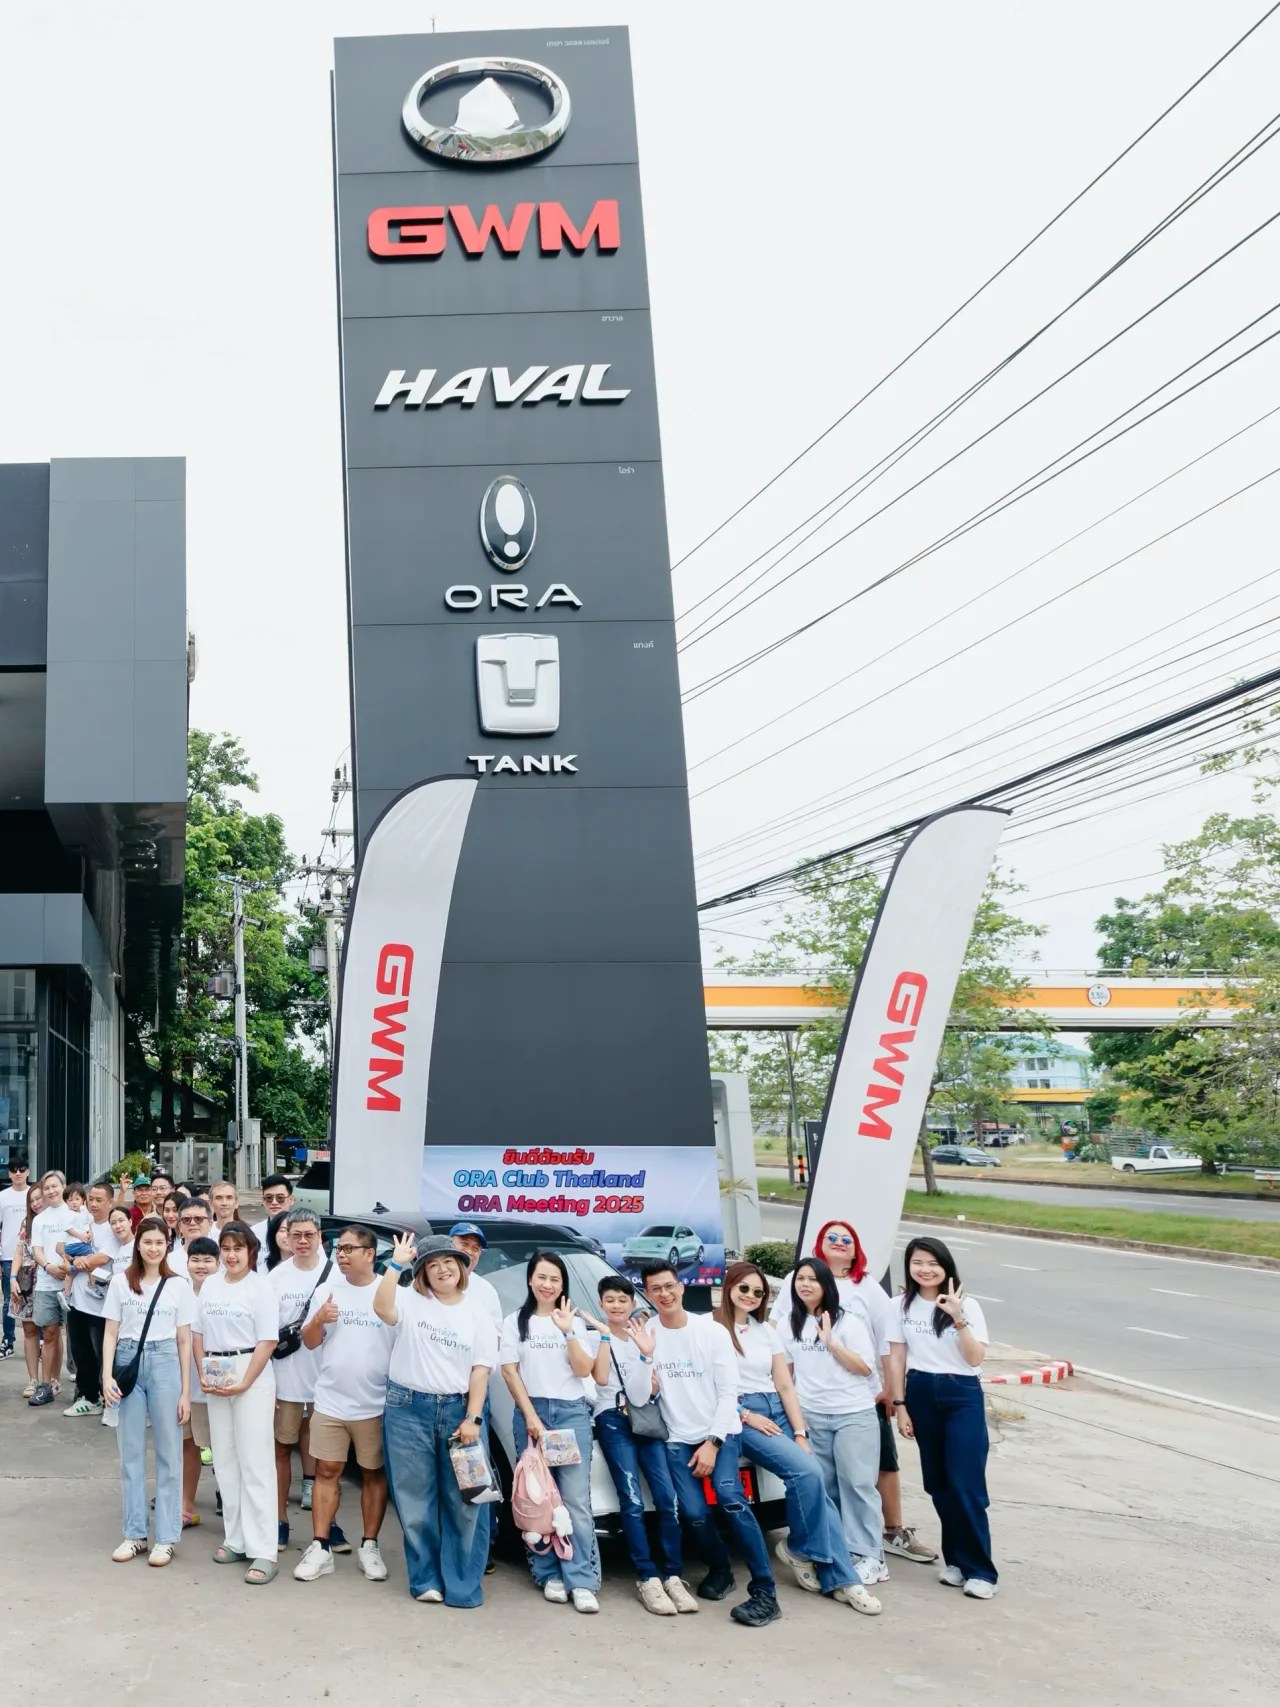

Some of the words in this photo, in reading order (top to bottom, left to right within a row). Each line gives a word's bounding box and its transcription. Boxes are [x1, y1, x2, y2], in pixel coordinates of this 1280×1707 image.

[367, 199, 620, 261] GWM
[374, 363, 631, 408] HAVAL
[444, 583, 583, 611] ORA
[467, 754, 579, 776] TANK
[366, 943, 415, 1112] GWM
[858, 971, 928, 1140] GWM
[502, 1147, 595, 1165] ยินดีต้อนรับ
[453, 1170, 498, 1188] ORA
[502, 1170, 549, 1188] Club
[553, 1170, 646, 1188] Thailand
[458, 1195, 502, 1213] ORA
[506, 1195, 590, 1216] Meeting
[593, 1195, 645, 1214] 2025
